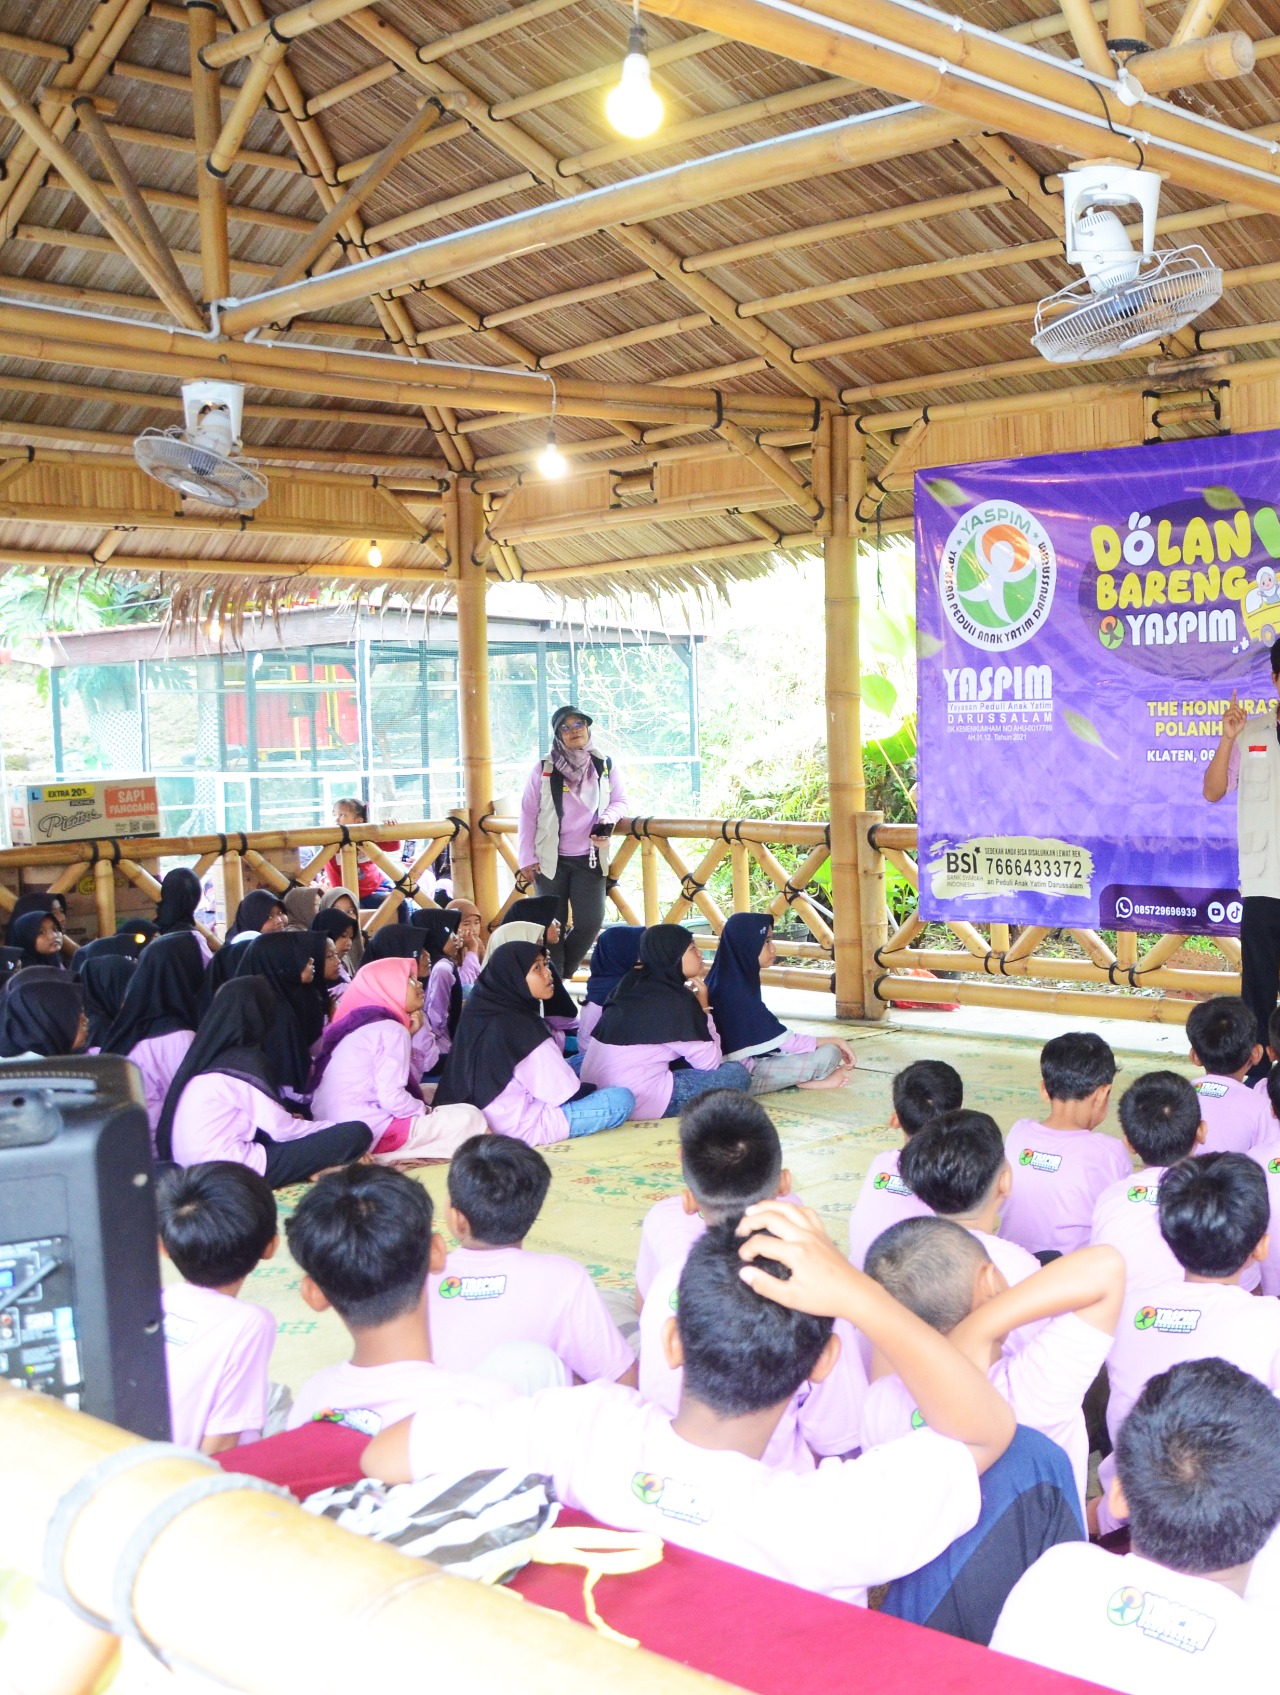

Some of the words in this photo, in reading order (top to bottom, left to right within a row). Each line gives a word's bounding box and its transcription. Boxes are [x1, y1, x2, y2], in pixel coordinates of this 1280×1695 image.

[960, 508, 1031, 535] YASPIM
[1096, 564, 1252, 610] BARENG
[949, 603, 977, 636] PEDULI
[977, 631, 1003, 643] ANAK
[1005, 618, 1035, 642] YATIM
[1126, 609, 1238, 646] YASPIM
[942, 664, 1052, 701] YASPIM
[949, 703, 978, 712] Yayasan
[980, 702, 1006, 711] Peduli
[1007, 702, 1028, 710] Anak
[1031, 701, 1052, 710] Yatim
[1147, 701, 1178, 717] THE
[947, 712, 1052, 724] DARUSSALAM
[1155, 721, 1223, 737] POLANH
[1147, 750, 1197, 763] KLATEN,
[48, 789, 70, 798] EXTRA
[118, 789, 145, 803] SAPI
[110, 802, 155, 814] PANGGANG
[986, 858, 1082, 878] 7666433372
[1134, 904, 1197, 917] 085729696939
